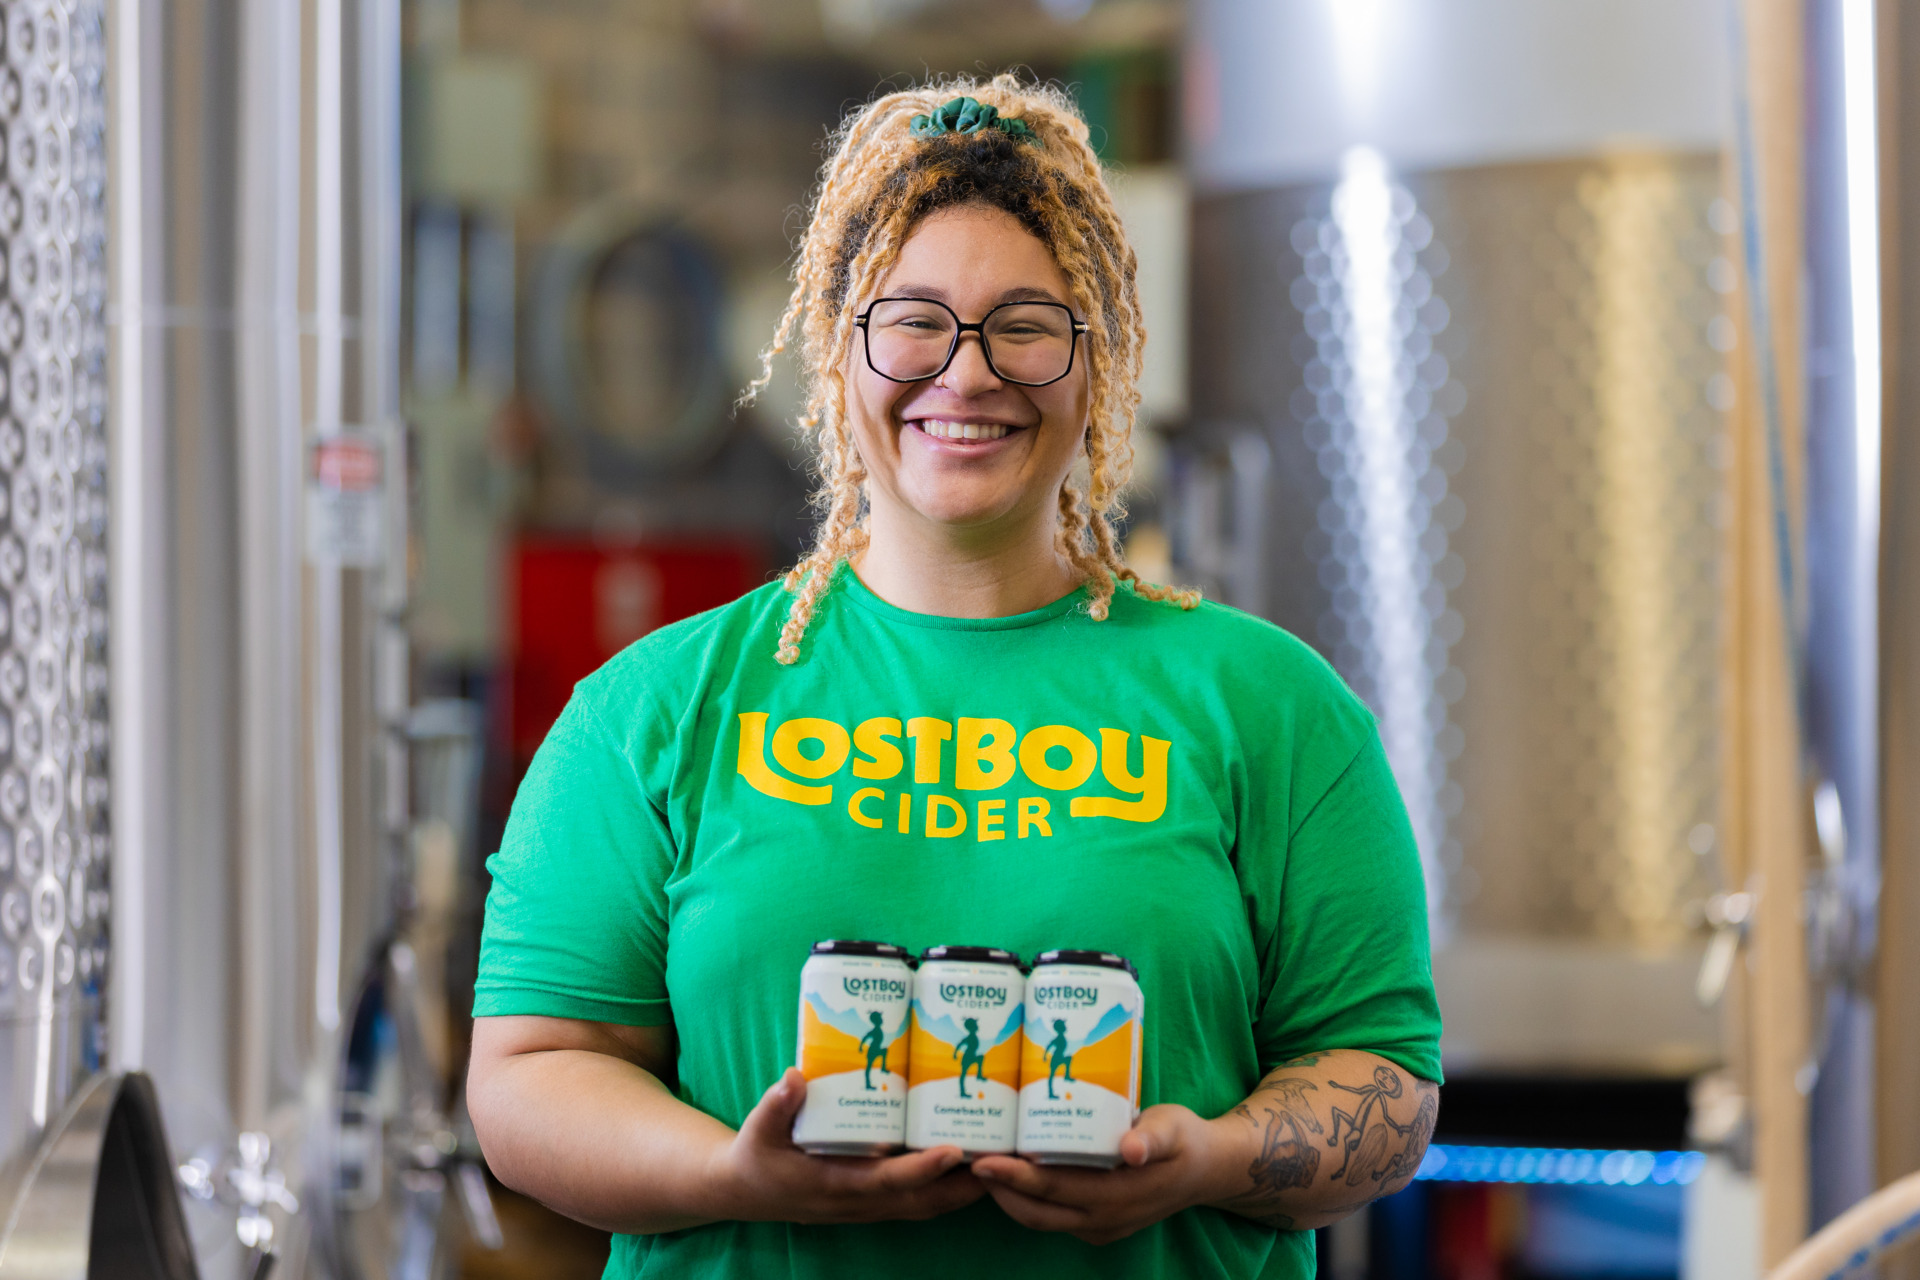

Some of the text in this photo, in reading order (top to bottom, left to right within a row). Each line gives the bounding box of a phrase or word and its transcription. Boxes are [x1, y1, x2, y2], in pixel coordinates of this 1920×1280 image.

[848, 787, 1053, 842] CIDER
[862, 992, 893, 1002] CIDER
[957, 999, 990, 1009] CIDER
[1047, 1001, 1079, 1010] CIDER
[838, 1097, 887, 1108] Comeback
[934, 1104, 985, 1115] Comeback
[1028, 1106, 1072, 1117] Comeback
